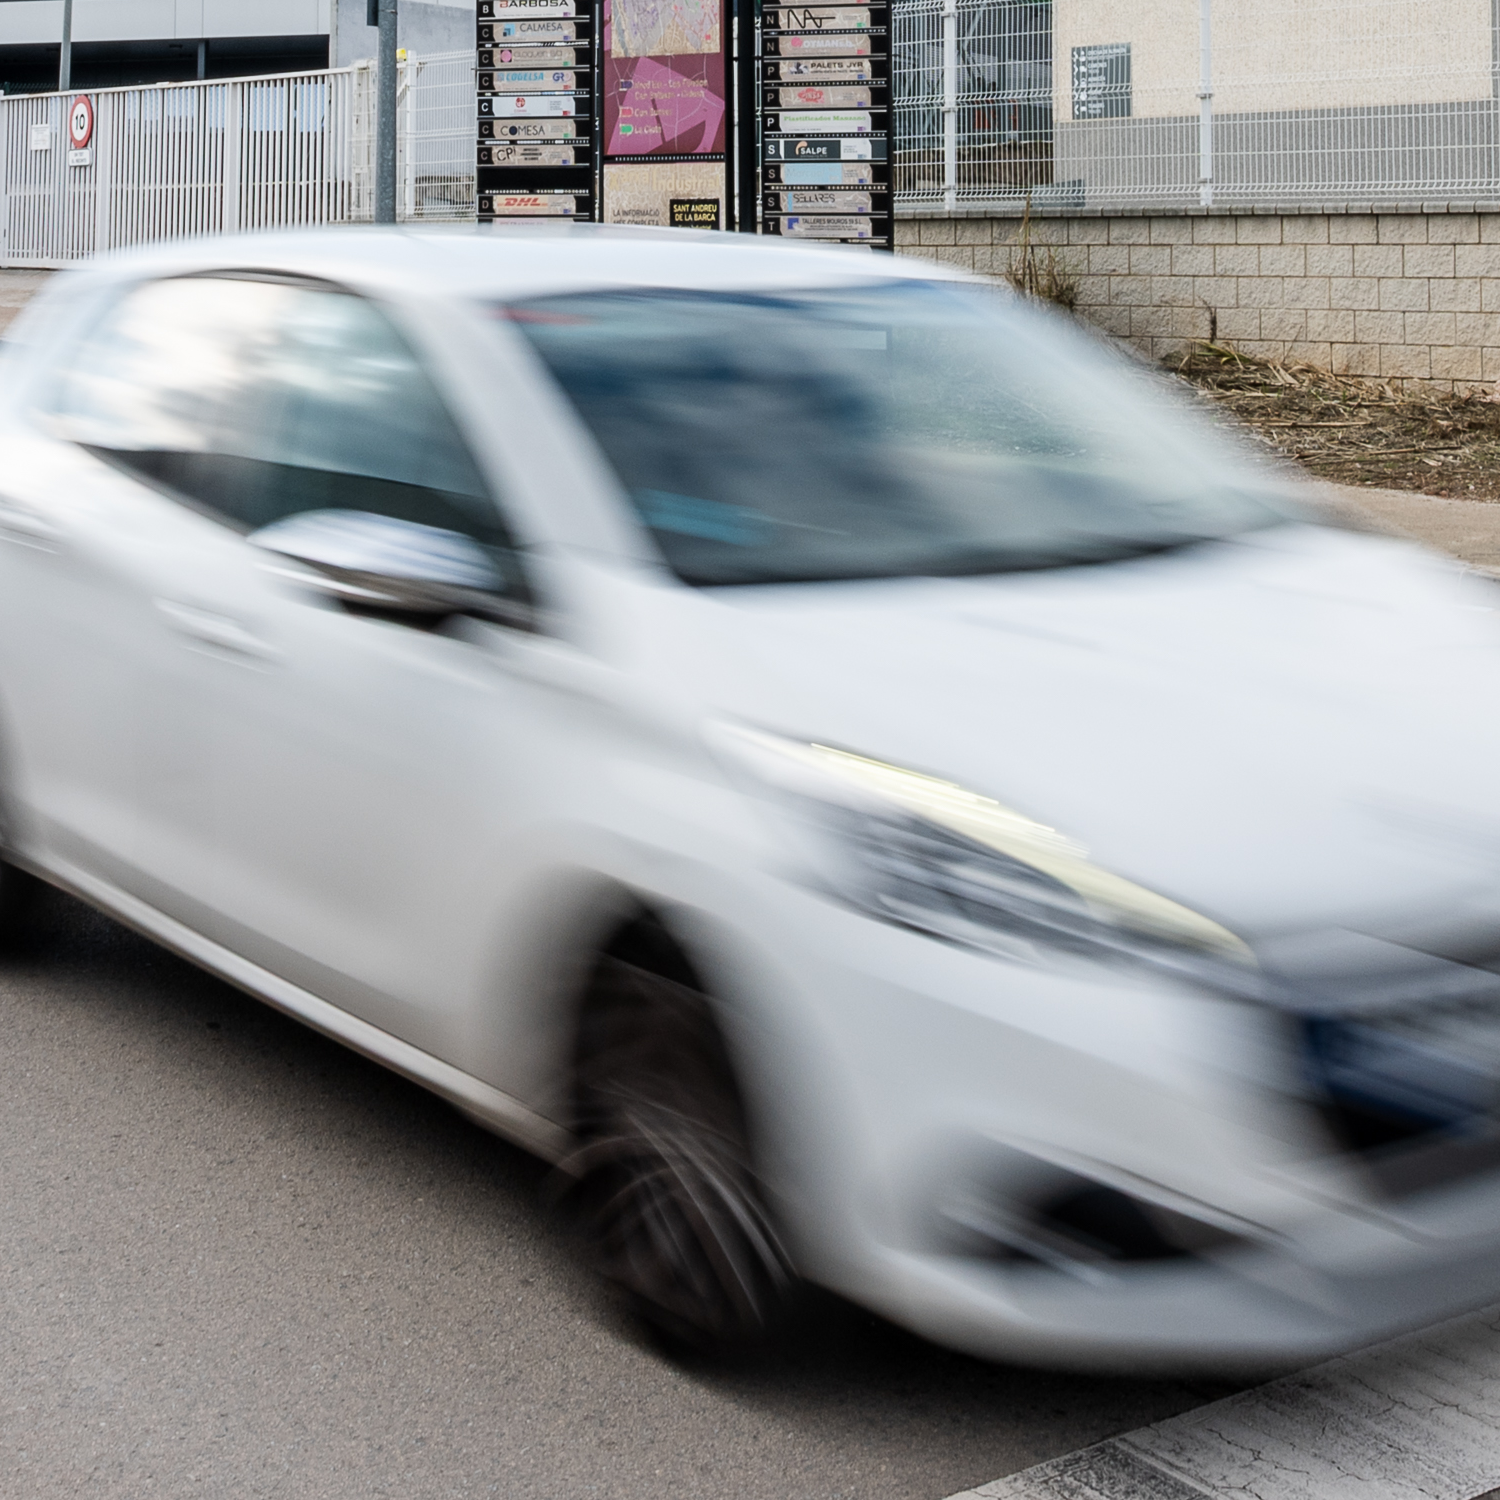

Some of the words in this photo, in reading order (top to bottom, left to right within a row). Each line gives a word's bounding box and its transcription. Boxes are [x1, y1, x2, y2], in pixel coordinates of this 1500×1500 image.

[483, 5, 489, 13] B
[500, 0, 569, 8] BARBOSA
[767, 15, 774, 24] N
[482, 29, 489, 37] C
[520, 23, 564, 32] CALMESA
[767, 42, 774, 51] N
[482, 54, 489, 63] C
[768, 67, 775, 76] P
[482, 77, 489, 86] C
[506, 72, 544, 81] COGELSA
[768, 93, 774, 102] P
[481, 103, 488, 112] C
[75, 114, 85, 130] 10
[768, 118, 775, 127] P
[482, 125, 489, 134] C
[500, 125, 545, 136] COMESA
[768, 145, 775, 154] S
[800, 146, 827, 155] SALPE
[481, 151, 488, 160] C
[768, 169, 775, 178] S
[482, 200, 489, 208] D
[504, 198, 540, 206] DHL
[768, 197, 775, 206] S
[793, 193, 835, 203] SELLARES
[673, 204, 690, 212] SANT
[691, 204, 717, 212] ANDREU
[613, 209, 620, 217] LA
[675, 213, 683, 221] DE
[684, 213, 692, 221] LA
[694, 213, 716, 221] BARCA
[768, 222, 775, 231] T
